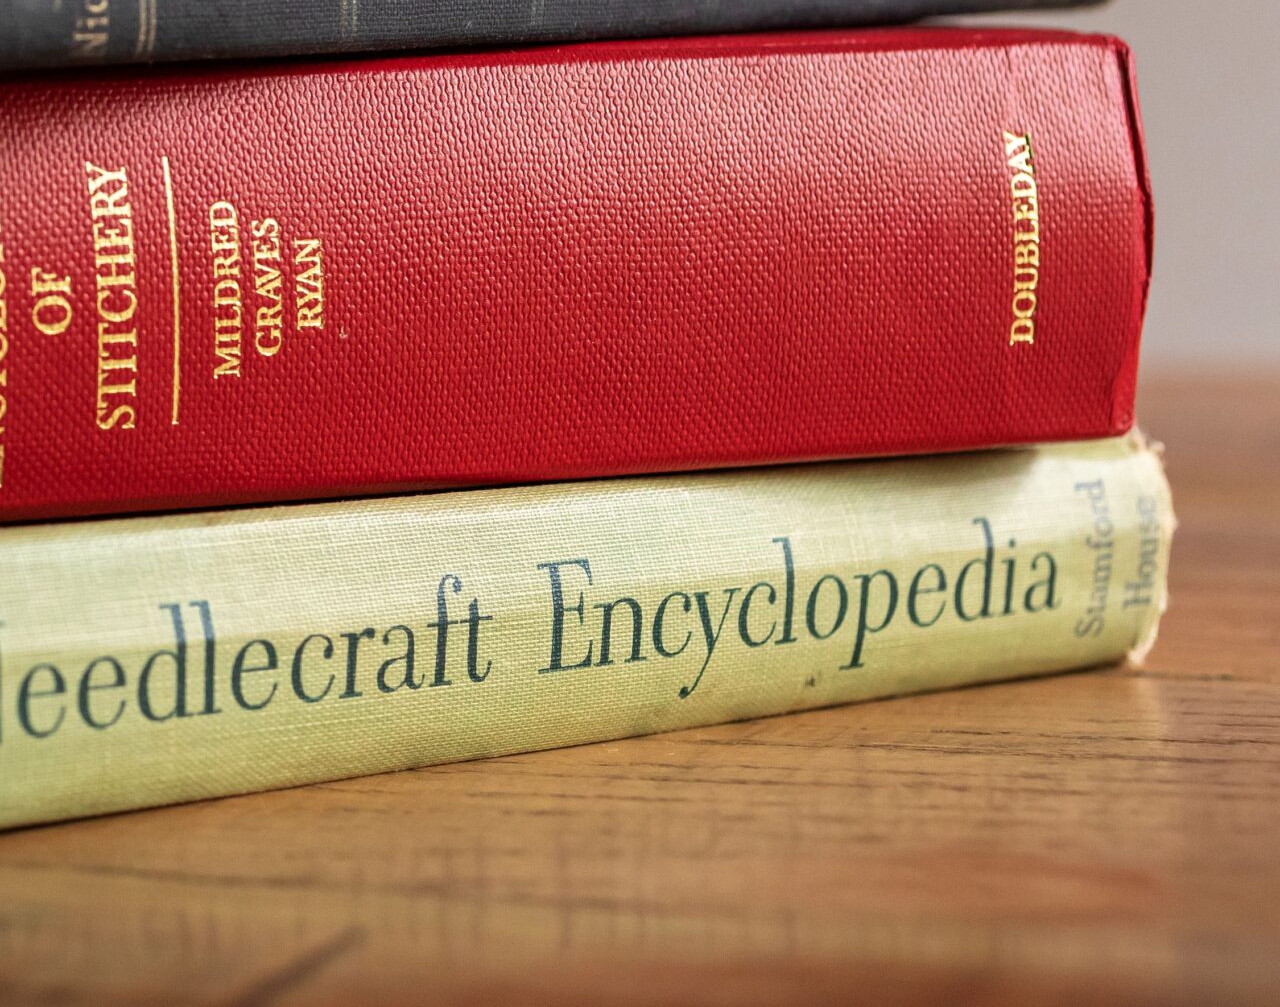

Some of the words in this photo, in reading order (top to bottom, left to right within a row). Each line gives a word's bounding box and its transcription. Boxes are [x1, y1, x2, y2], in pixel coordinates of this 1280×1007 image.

[31, 266, 73, 336] OF
[85, 161, 138, 430] STITCHERY
[209, 200, 241, 379] MILDRED
[252, 216, 282, 357] GRAVES
[293, 237, 324, 331] RYAN
[1003, 130, 1040, 346] DOUBLEDAY
[536, 517, 1061, 699] Encyclopedia
[1122, 496, 1160, 609] House
